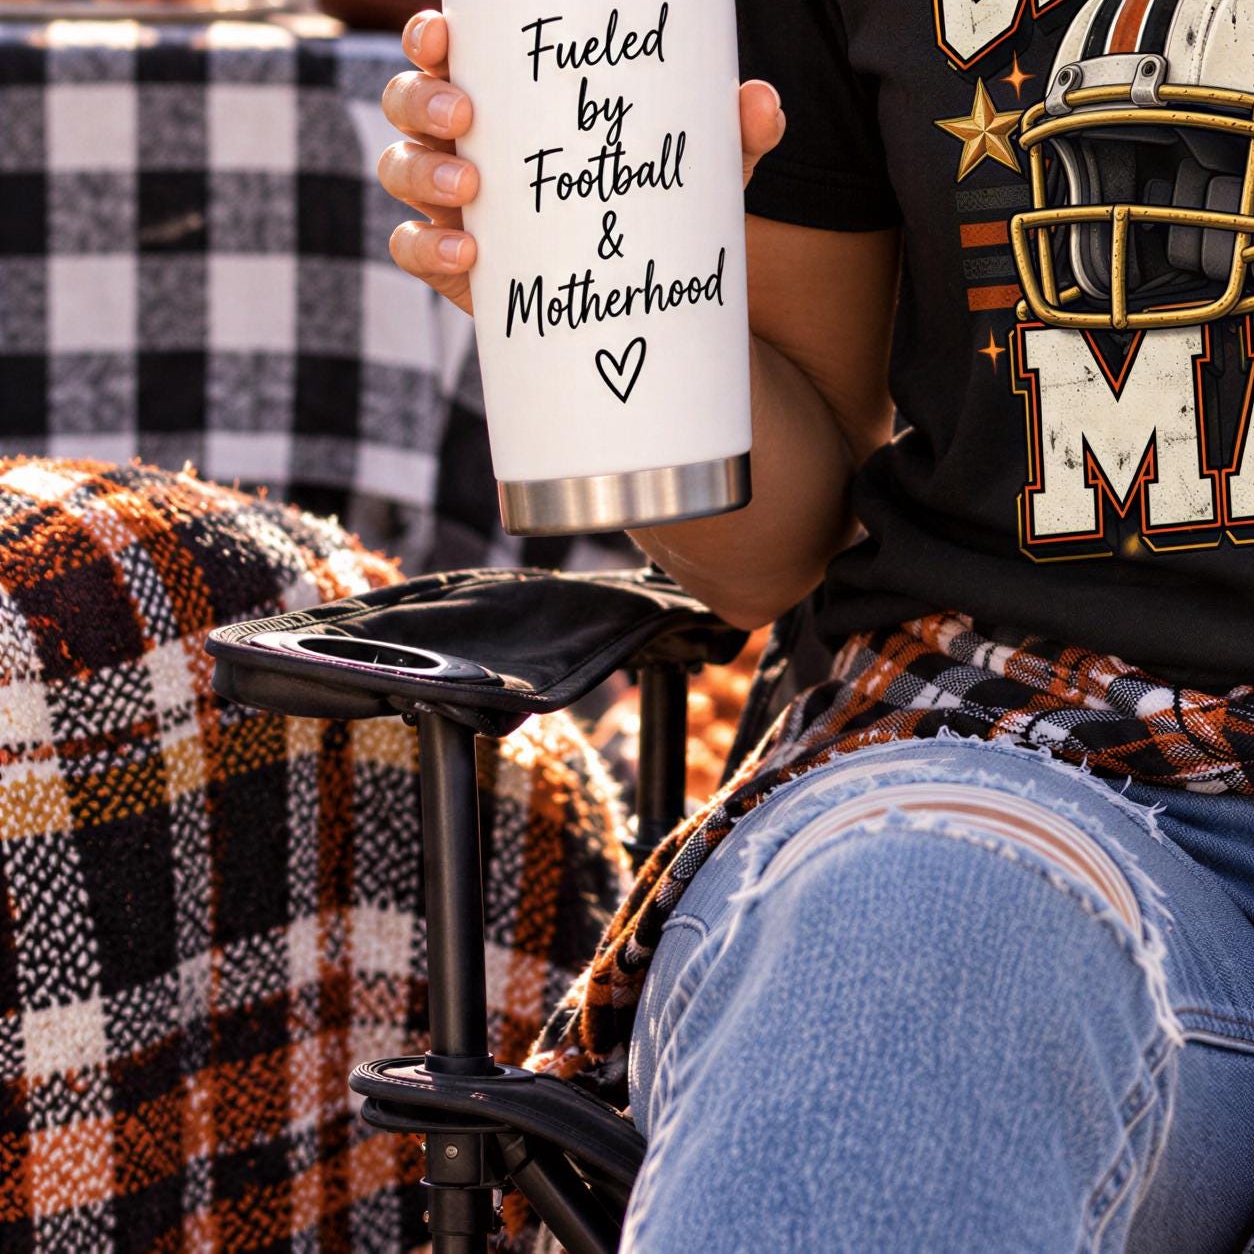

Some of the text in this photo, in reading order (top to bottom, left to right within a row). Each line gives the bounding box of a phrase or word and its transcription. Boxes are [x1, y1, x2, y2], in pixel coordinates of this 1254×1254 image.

[521, 2, 669, 82] Fueled
[578, 77, 634, 146] by
[524, 130, 686, 213] Football
[597, 210, 625, 260] &
[505, 247, 726, 338] Motherhood
